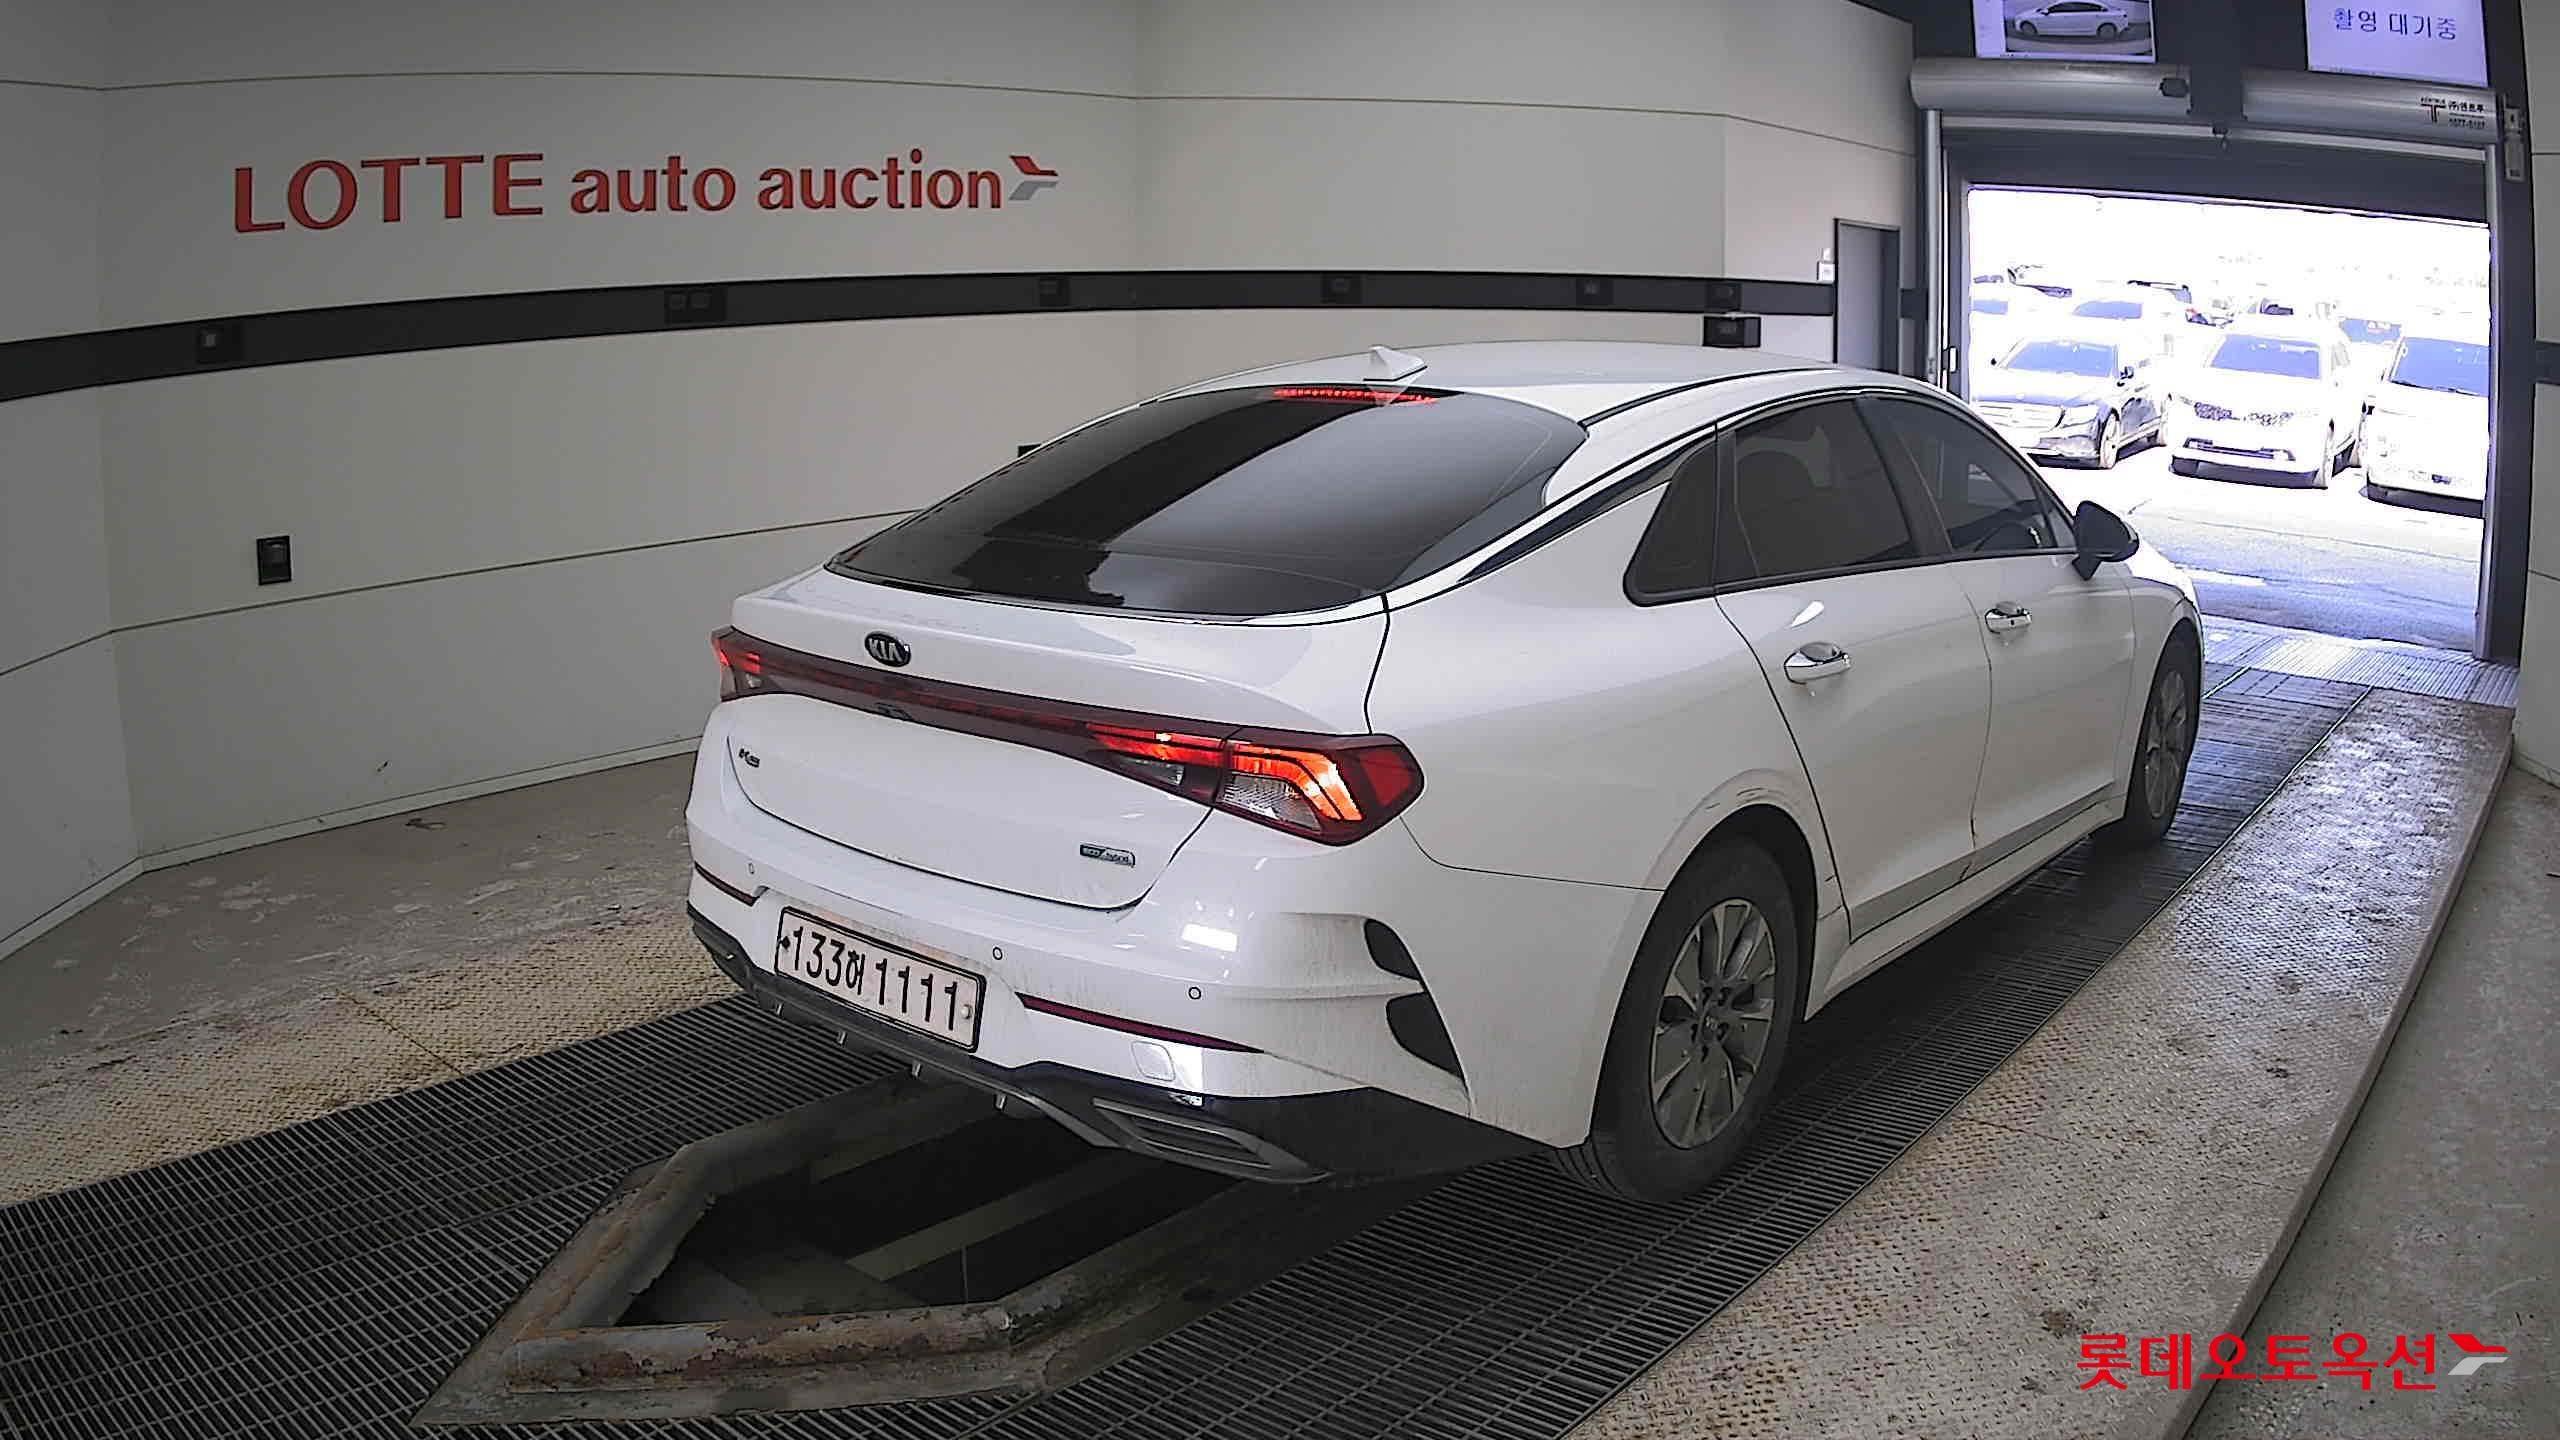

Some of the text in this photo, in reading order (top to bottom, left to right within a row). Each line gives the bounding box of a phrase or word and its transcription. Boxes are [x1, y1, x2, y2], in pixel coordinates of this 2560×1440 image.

[2334, 7, 2457, 41] 촬영 대기중
[234, 148, 1004, 234] LOTTE auto auction
[867, 637, 904, 663] KIA
